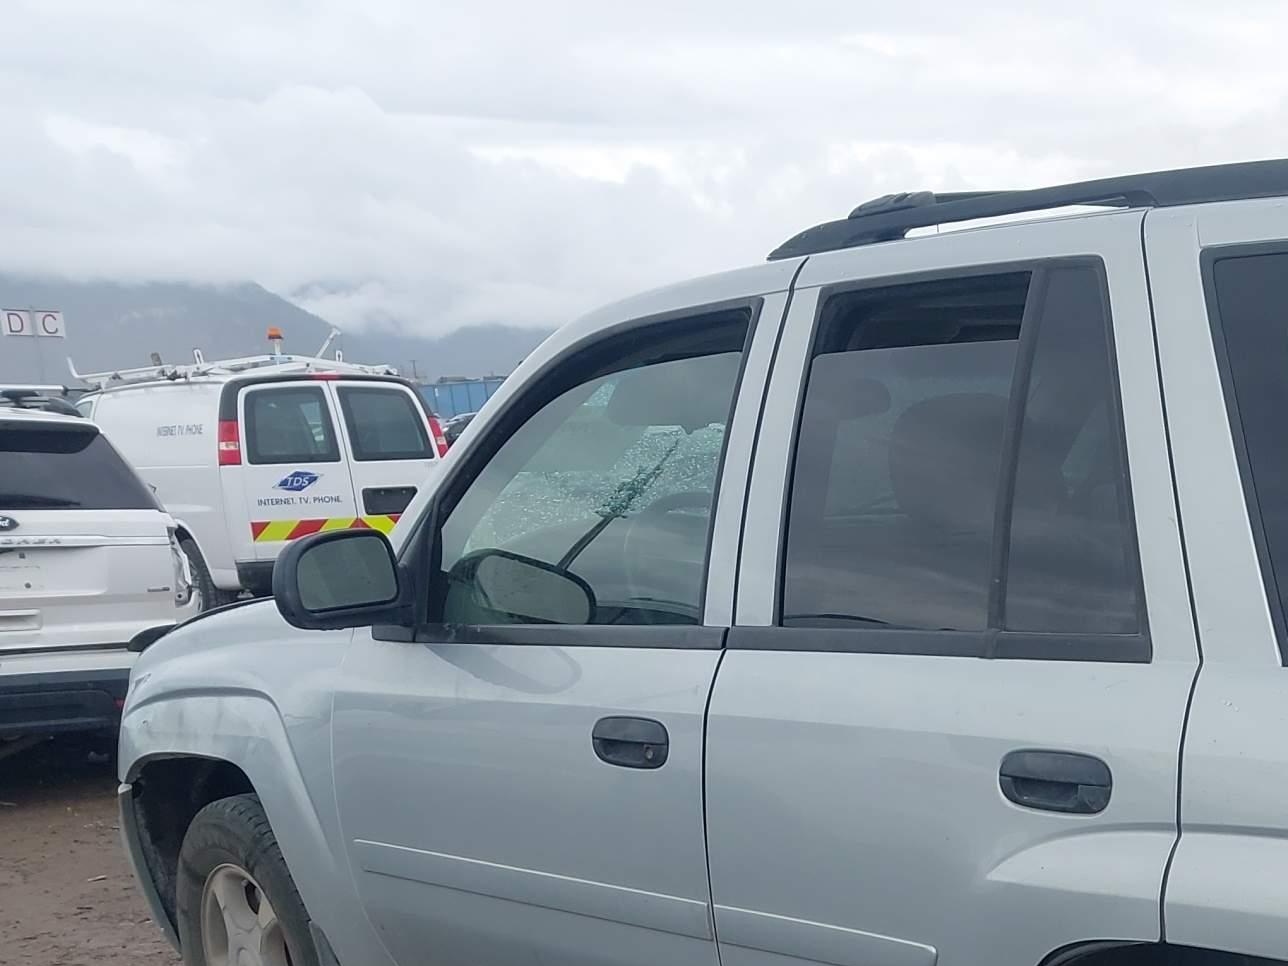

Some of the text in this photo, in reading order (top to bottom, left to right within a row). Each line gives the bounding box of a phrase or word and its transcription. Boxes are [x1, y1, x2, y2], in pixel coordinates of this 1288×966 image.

[7, 313, 24, 333] D
[42, 314, 58, 334] C
[286, 476, 310, 487] TDS
